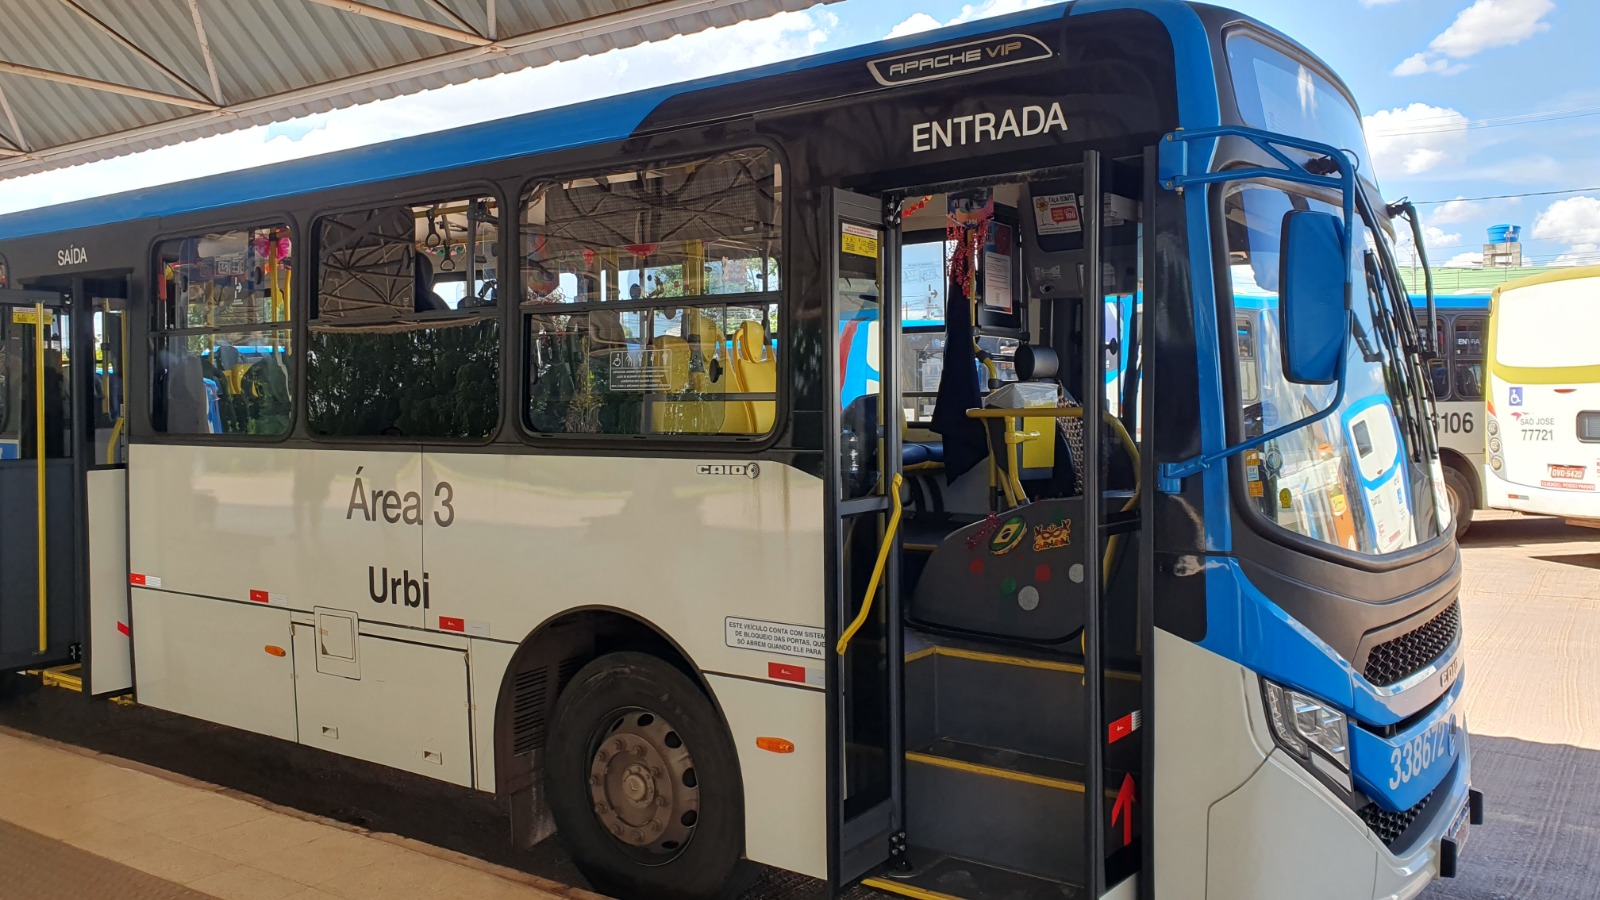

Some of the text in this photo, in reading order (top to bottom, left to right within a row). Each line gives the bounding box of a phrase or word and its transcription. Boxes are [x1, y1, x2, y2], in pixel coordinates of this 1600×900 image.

[889, 41, 1022, 76] APACHE VIP
[912, 102, 1068, 153] ENTRADA
[57, 244, 88, 267] SAÍDA
[1521, 429, 1554, 441] 77721
[696, 464, 747, 476] CAIO
[346, 466, 455, 527] Área 3
[368, 565, 430, 609] Urbi
[728, 621, 743, 629] ESTE
[743, 623, 768, 632] VEÍCULO
[768, 626, 789, 635] CONTA
[789, 629, 804, 637] COM
[743, 631, 773, 641] BLOQUEIO
[773, 635, 786, 643] DAS
[786, 637, 812, 647] PORTAS,
[812, 640, 826, 648] QUE
[736, 637, 822, 656] SÓ ABREM QUANDO ELE PARA
[1389, 720, 1446, 791] 338672
